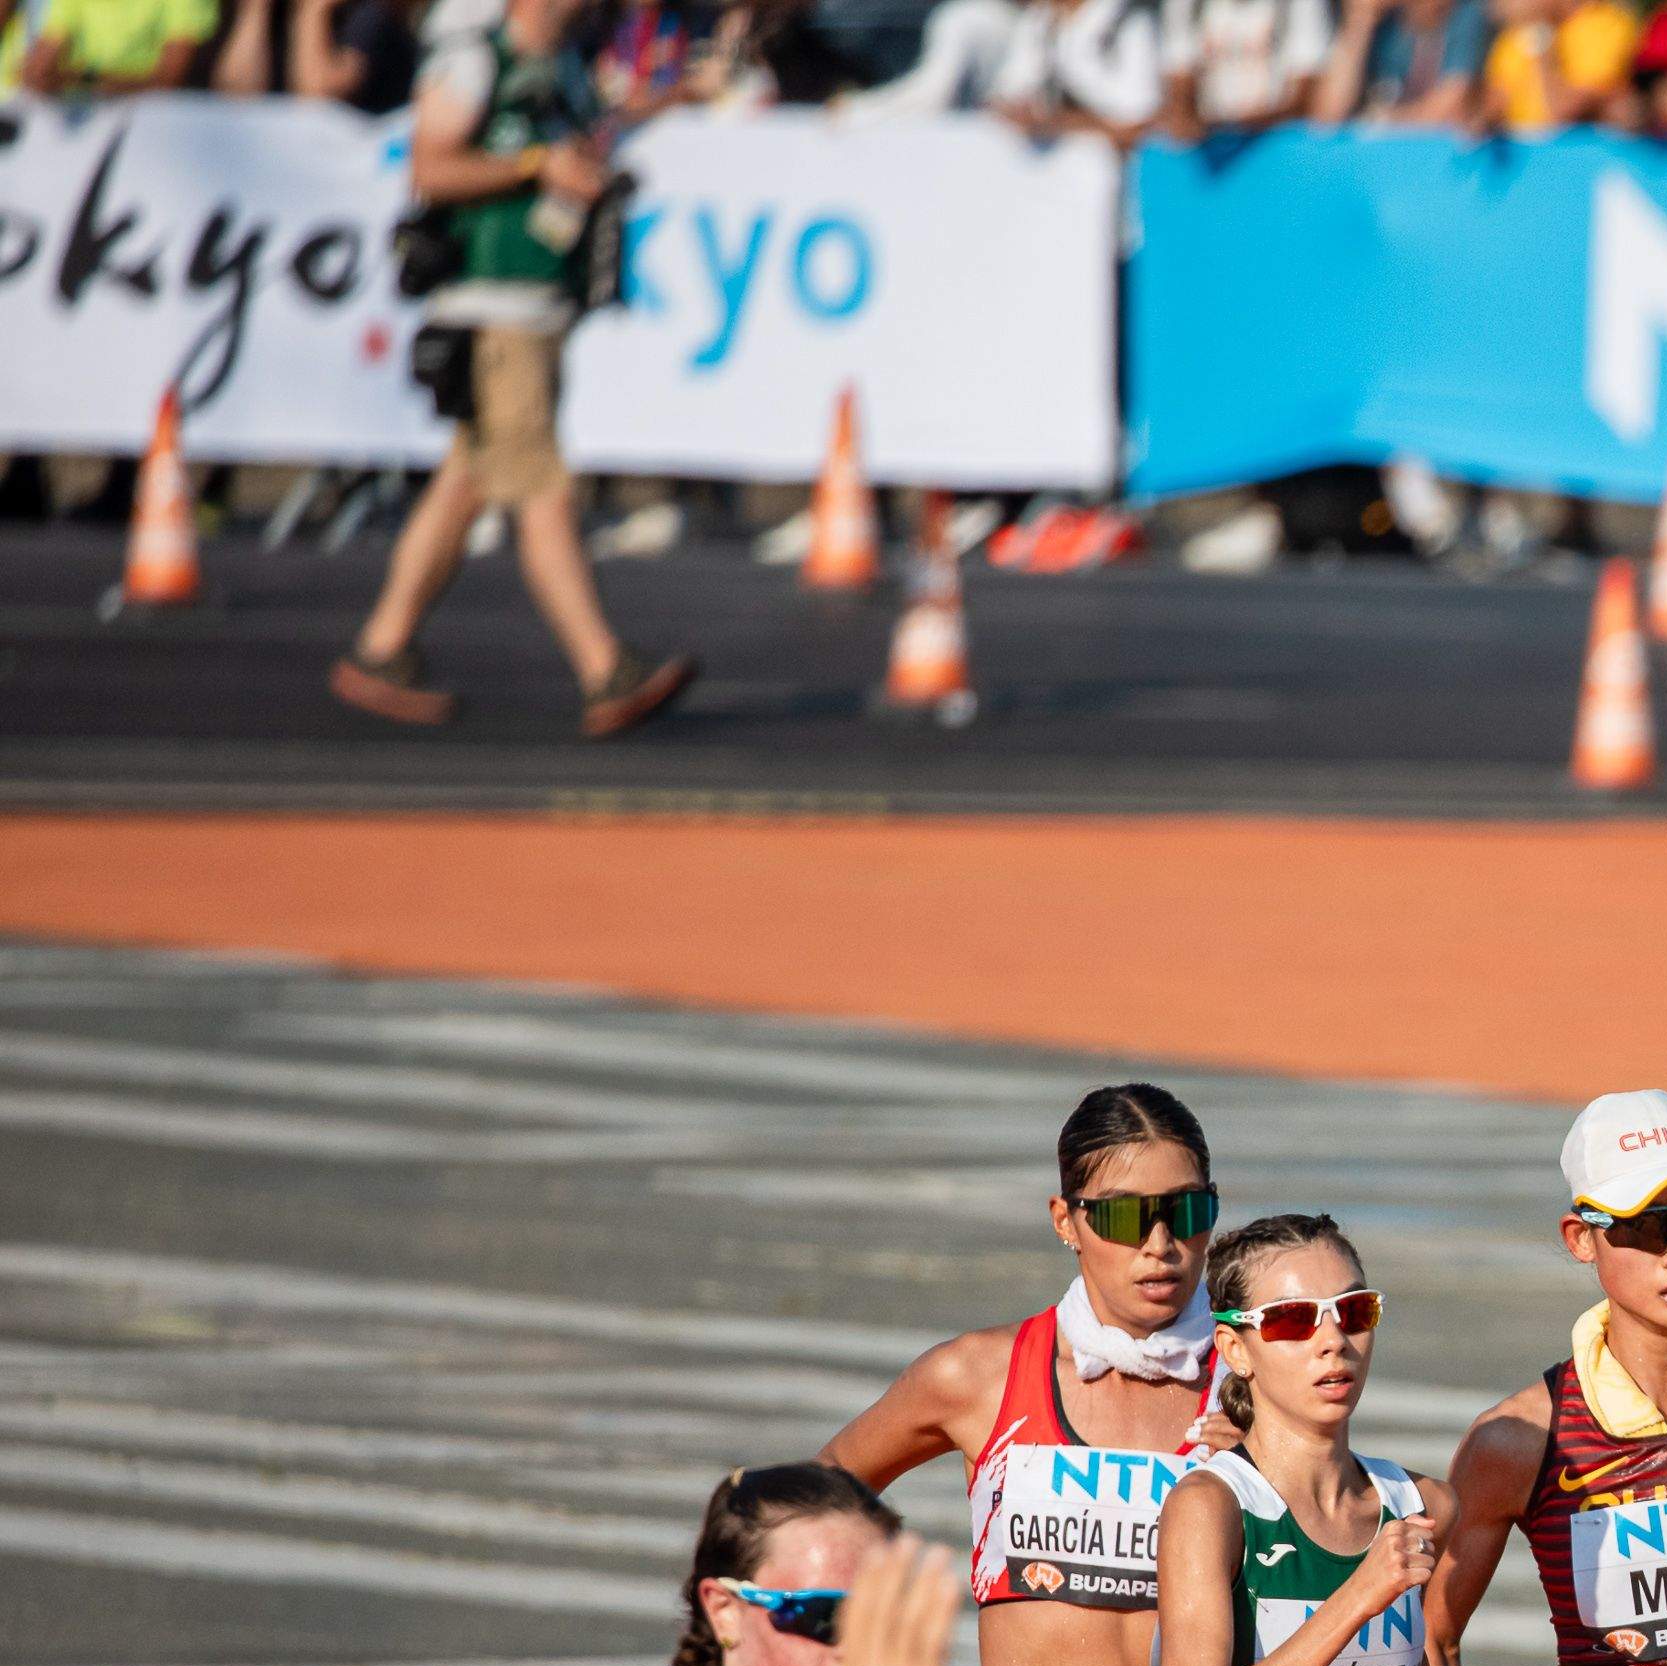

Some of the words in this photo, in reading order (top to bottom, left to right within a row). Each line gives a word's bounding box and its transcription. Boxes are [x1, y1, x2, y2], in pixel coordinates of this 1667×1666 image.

[0, 110, 362, 412] okyo
[1010, 1509, 1104, 1556] GARCÍA
[1115, 1516, 1158, 1561] LEÓ
[1069, 1573, 1158, 1597] BUDAPE
